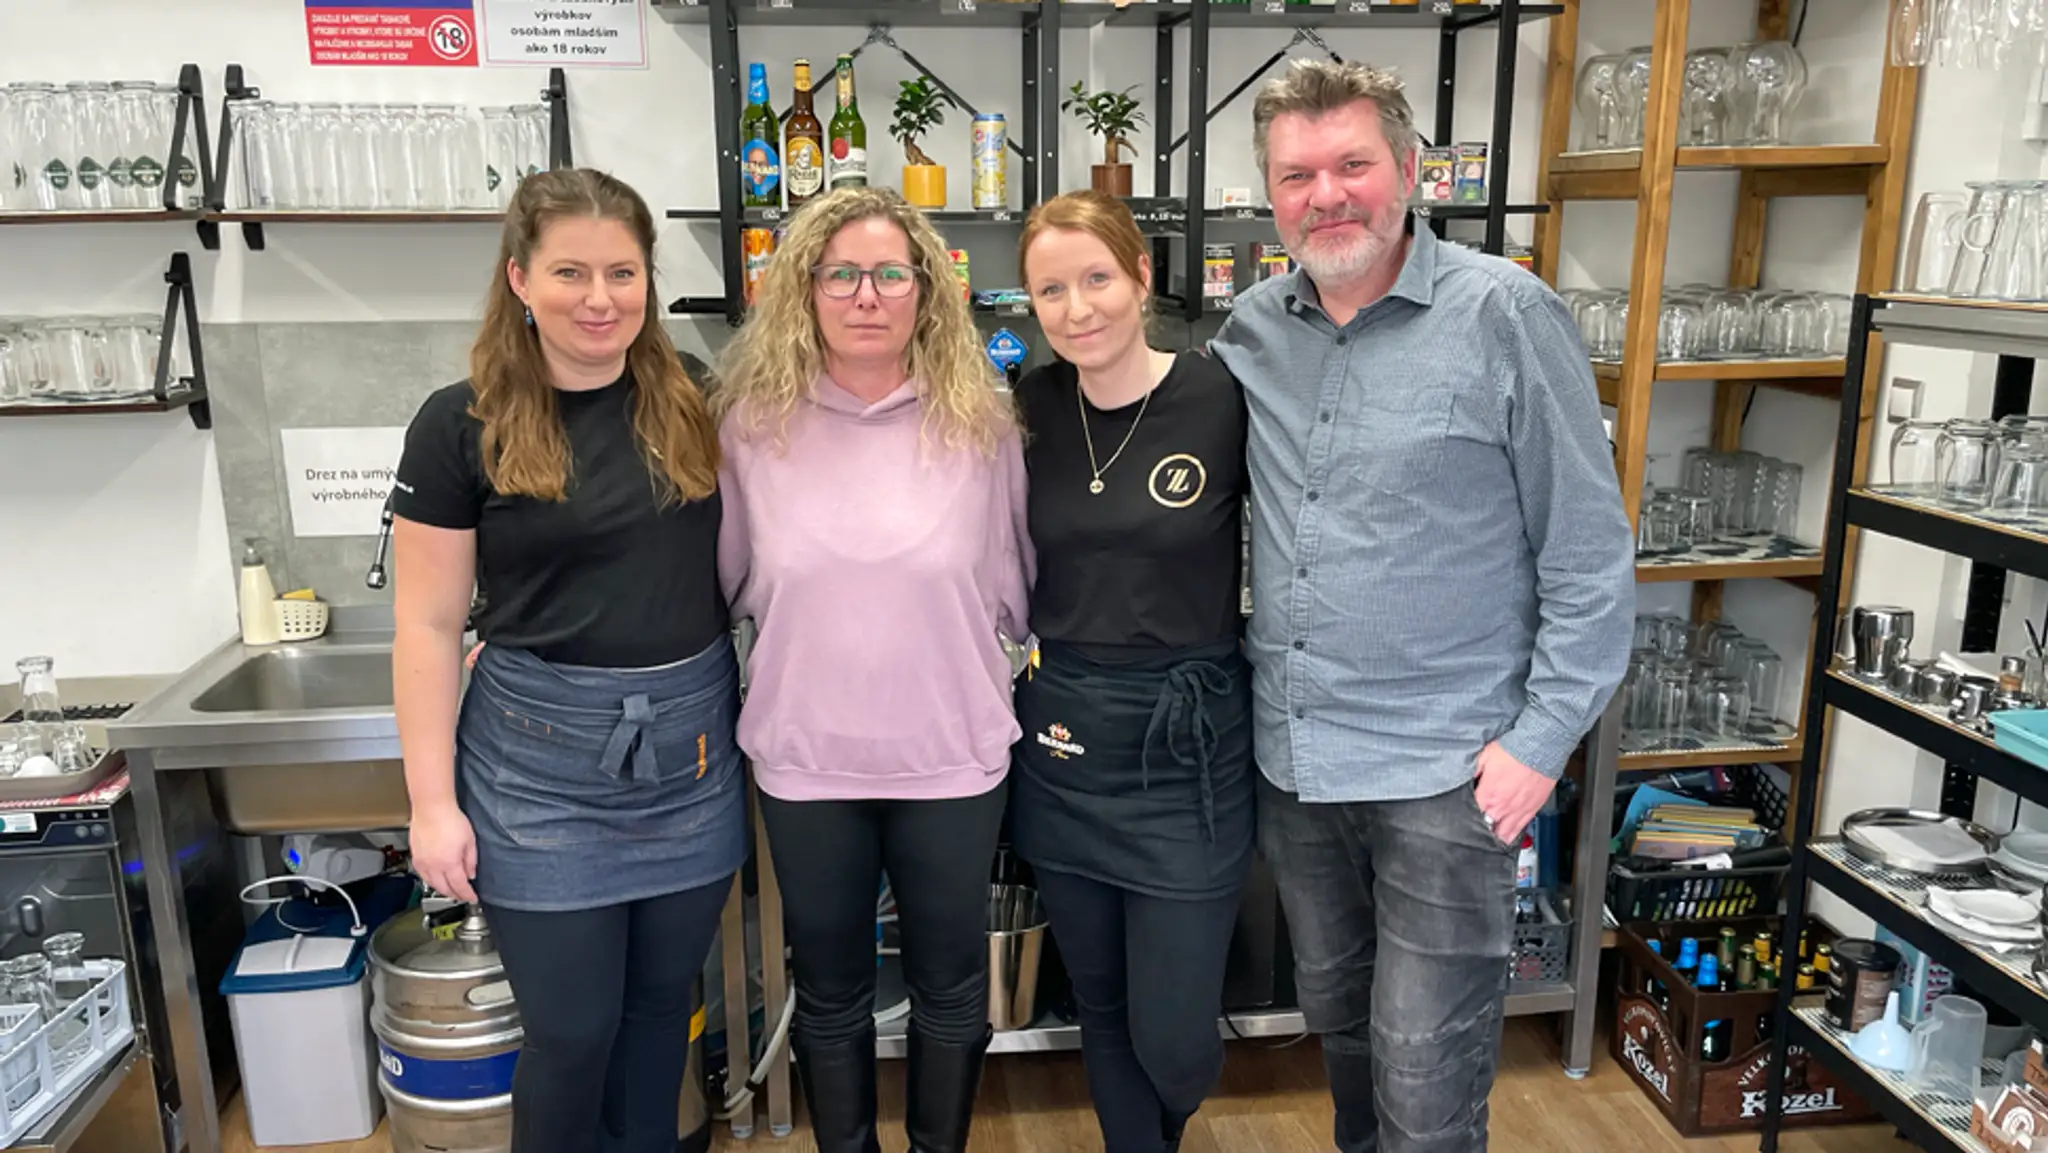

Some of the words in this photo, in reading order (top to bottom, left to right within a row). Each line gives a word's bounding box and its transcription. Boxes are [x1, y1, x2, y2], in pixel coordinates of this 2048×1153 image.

[534, 9, 592, 22] výrobkov
[436, 27, 464, 49] 18
[510, 26, 561, 37] osobám
[563, 26, 618, 38] mladším
[525, 42, 548, 53] ako
[552, 43, 568, 54] 18
[571, 43, 607, 54] rokov
[305, 468, 337, 481] Drez
[340, 470, 358, 480] na
[312, 488, 388, 504] výrobného
[1623, 1031, 1671, 1103] Kozel
